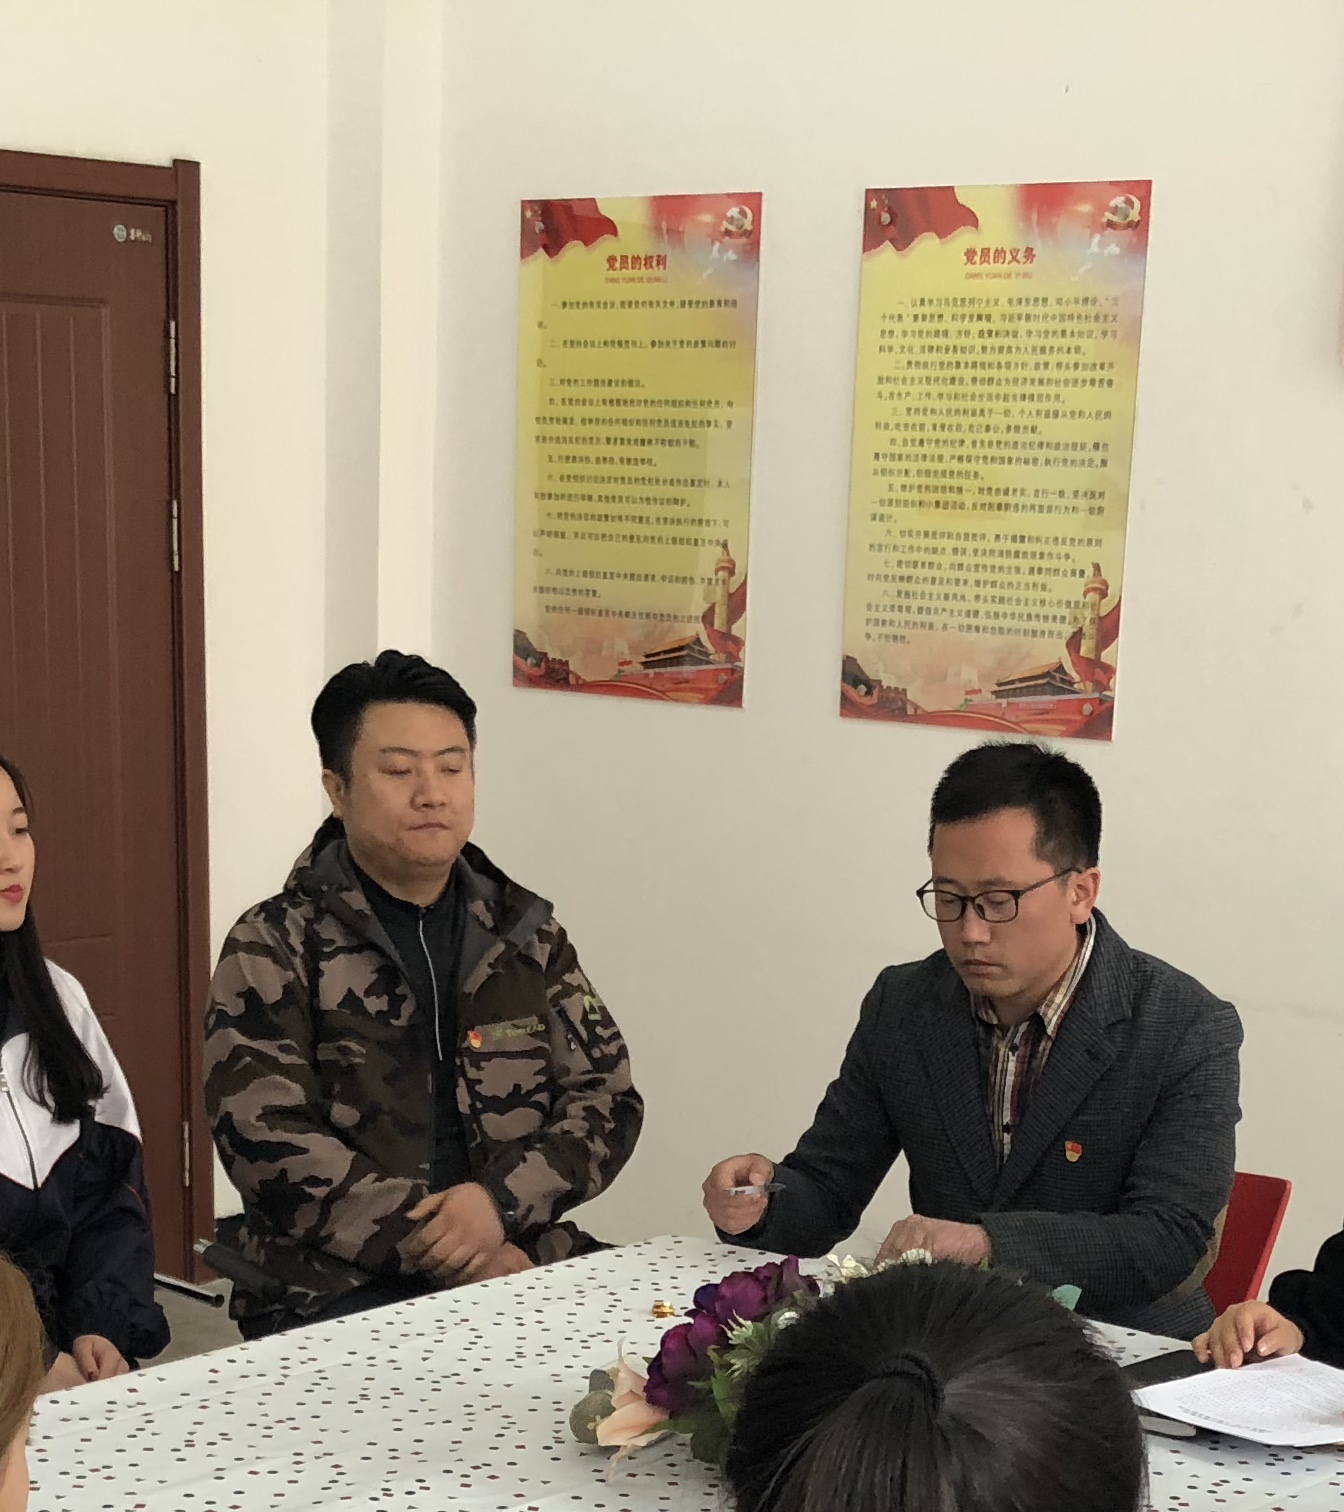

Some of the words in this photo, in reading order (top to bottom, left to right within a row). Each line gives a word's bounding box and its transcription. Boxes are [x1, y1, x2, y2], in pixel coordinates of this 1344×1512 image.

[606, 253, 668, 272] 党员的权利
[964, 246, 1036, 266] 党员的义务
